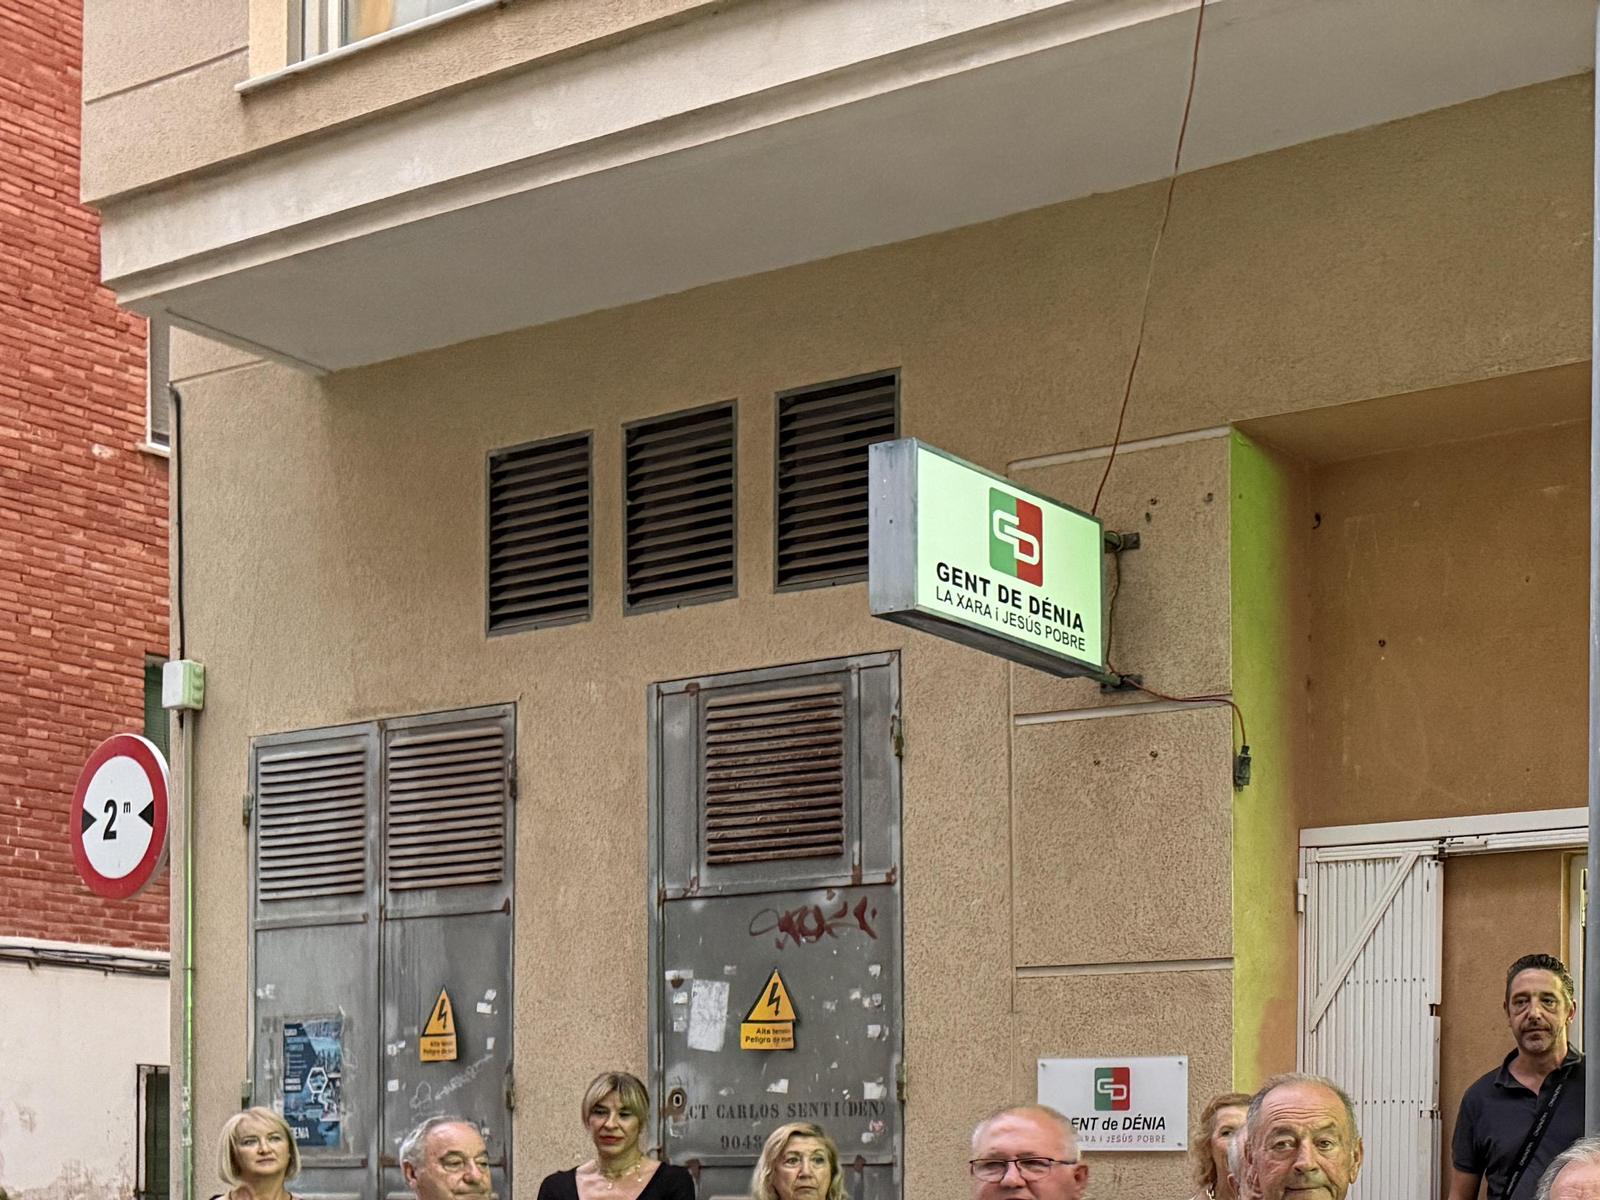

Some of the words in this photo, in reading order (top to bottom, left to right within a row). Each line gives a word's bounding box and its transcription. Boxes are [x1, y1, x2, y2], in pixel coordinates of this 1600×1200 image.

[936, 562, 991, 597] GENT
[998, 584, 1022, 609] DE
[1029, 597, 1085, 633] DÉNIA
[936, 586, 953, 605] LA
[956, 593, 992, 619] XARA
[1002, 611, 1042, 636] JESÚS
[1045, 625, 1086, 652] POBRE
[102, 798, 117, 841] 2
[123, 801, 131, 814] m
[716, 1102, 780, 1120] CARLOS
[1071, 1117, 1099, 1131] ENT
[1102, 1117, 1118, 1131] de
[1122, 1114, 1166, 1131] DÉNIA
[1106, 1133, 1133, 1143] JESÚS
[1136, 1135, 1166, 1143] POBRE
